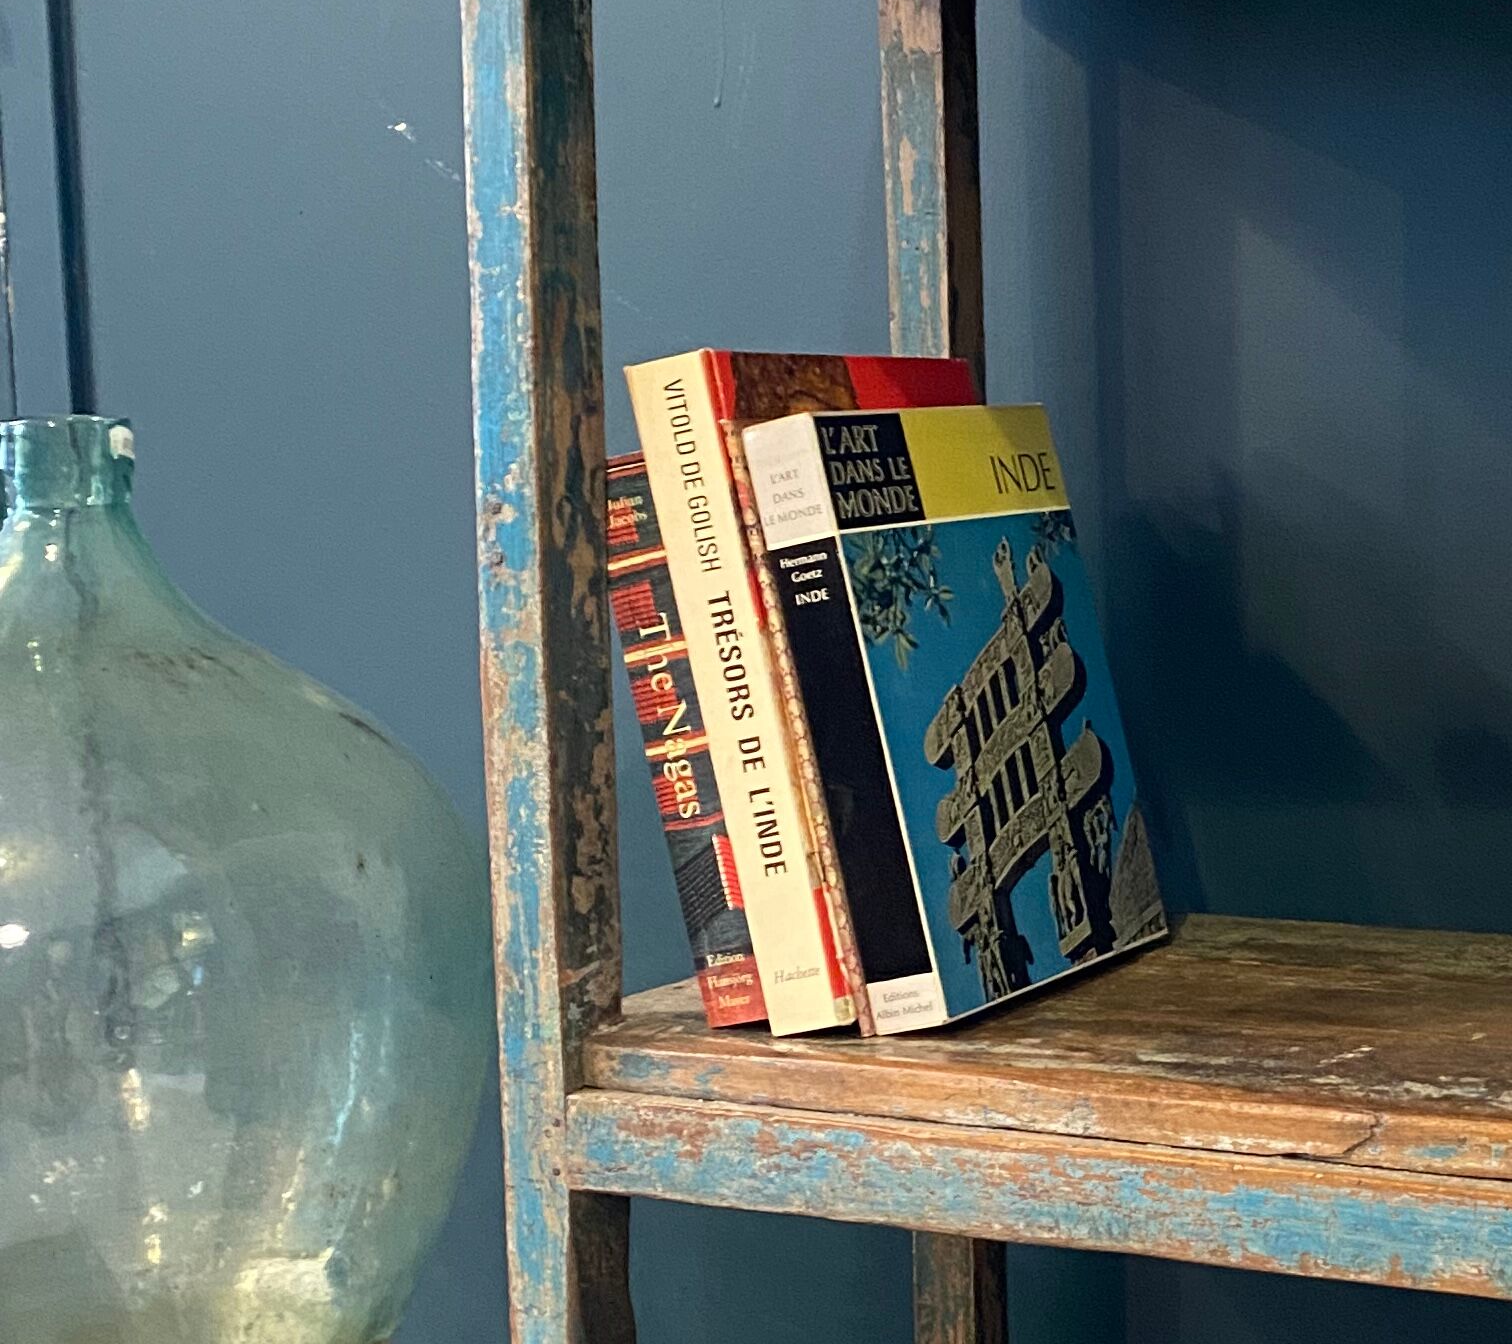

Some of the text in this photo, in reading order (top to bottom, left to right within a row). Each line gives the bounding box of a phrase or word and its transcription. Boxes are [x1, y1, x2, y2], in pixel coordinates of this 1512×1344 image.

[820, 425, 879, 455] L'ART
[663, 378, 722, 573] VITOLD DE GOLISH
[769, 468, 800, 484] L'ART
[830, 457, 912, 485] DANS LE
[989, 452, 1055, 494] INDE
[772, 488, 806, 504] DANS
[836, 485, 919, 519] MONDE
[764, 504, 823, 527] LE MONDE
[779, 552, 828, 569] Hermann
[795, 587, 830, 606] INDE
[639, 612, 701, 819] The Nagas
[707, 591, 787, 877] TRÉSORS DE L'INDE
